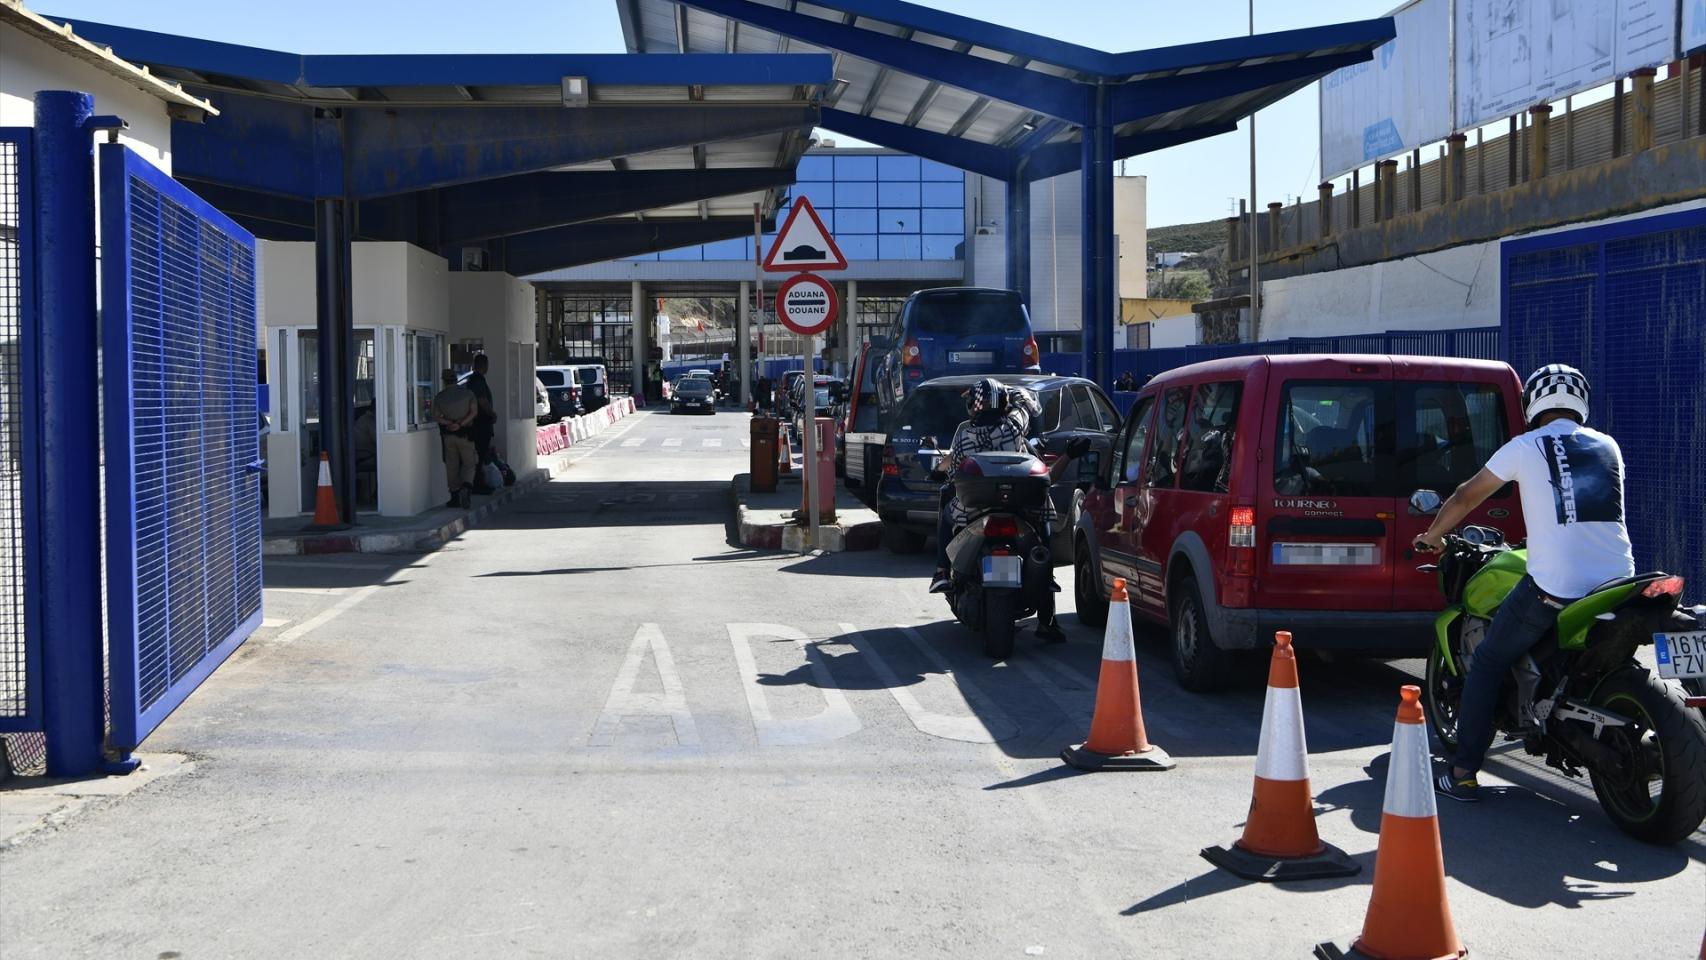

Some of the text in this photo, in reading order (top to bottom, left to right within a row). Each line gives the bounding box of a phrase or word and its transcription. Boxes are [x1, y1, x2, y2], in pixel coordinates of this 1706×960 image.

[1551, 435, 1577, 525] HOLLISTER
[1274, 499, 1337, 509] TOURNEO
[1672, 654, 1704, 675] FZV
